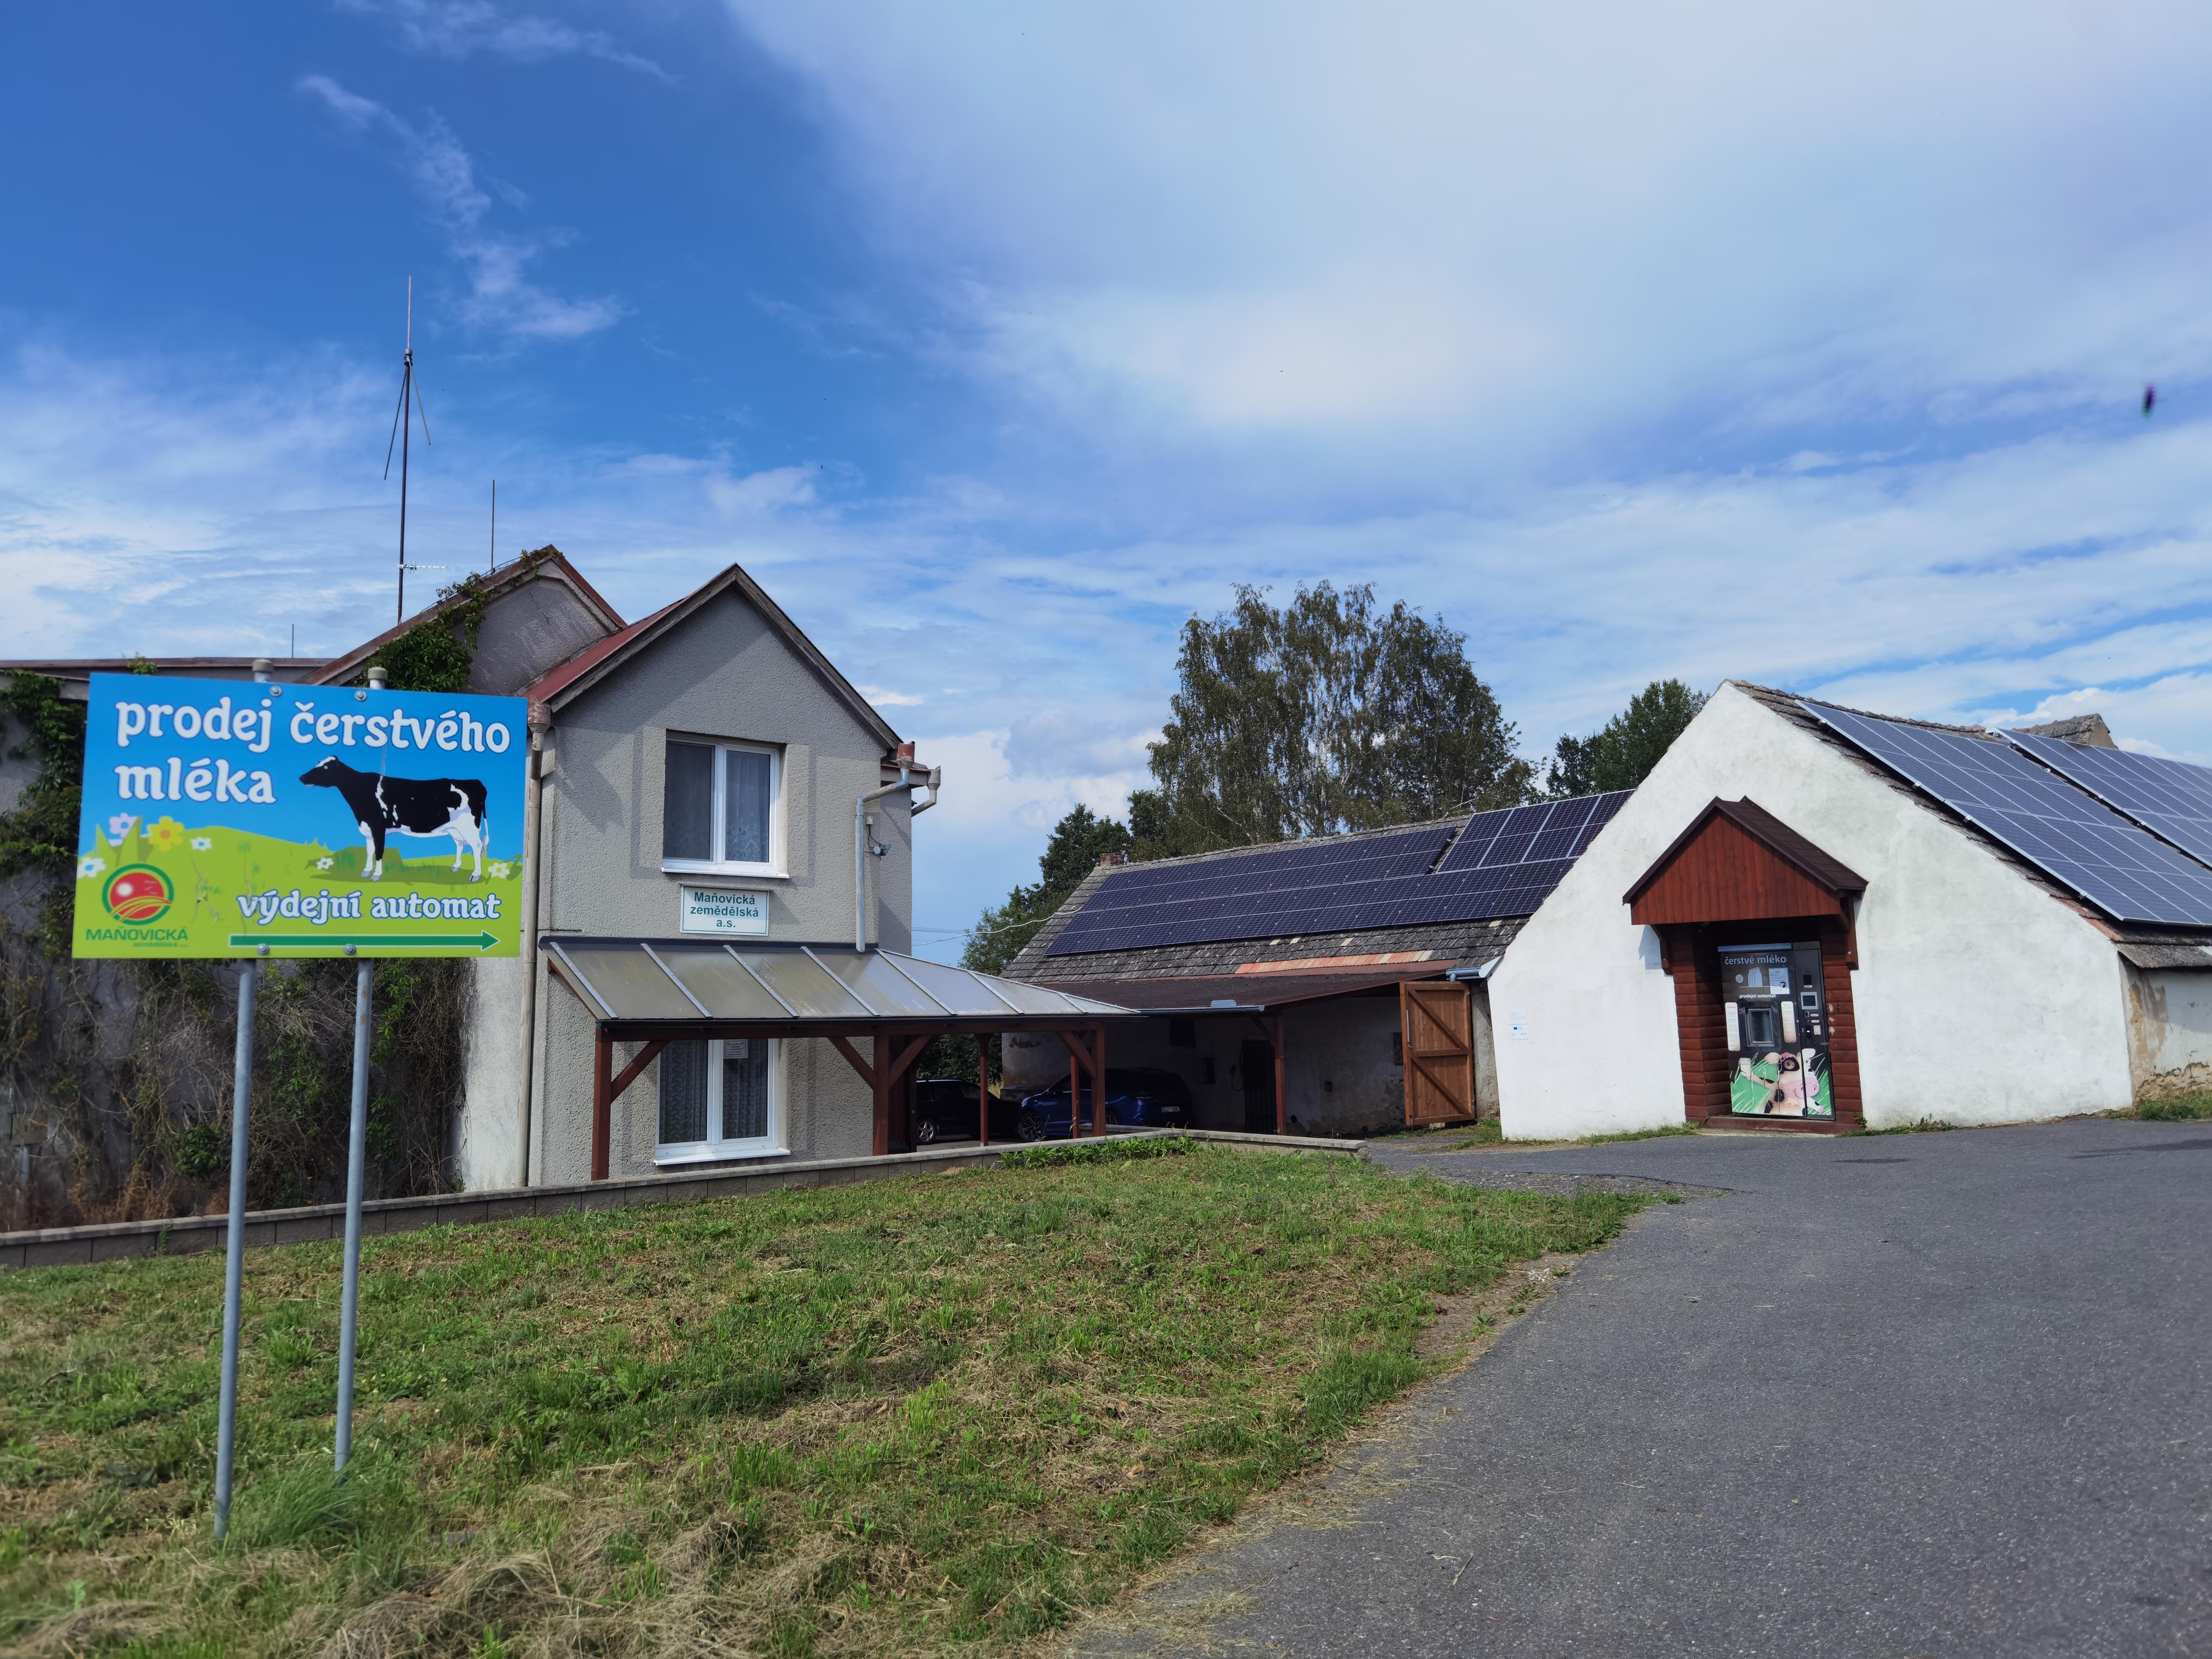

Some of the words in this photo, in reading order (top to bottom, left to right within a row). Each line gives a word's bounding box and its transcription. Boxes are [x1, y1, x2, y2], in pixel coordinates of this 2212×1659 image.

[115, 696, 272, 753] prodej
[289, 702, 511, 753] čerstvého
[113, 757, 278, 804] mléka
[694, 892, 755, 905] Maňovická
[236, 889, 362, 926] výdejní
[370, 892, 501, 920] automat
[690, 906, 759, 917] zemědělská
[716, 920, 736, 928] a.s.
[85, 926, 188, 941] MAŇOVICKÁ
[1724, 955, 1755, 965] čerstvé
[1757, 954, 1787, 964] mléko
